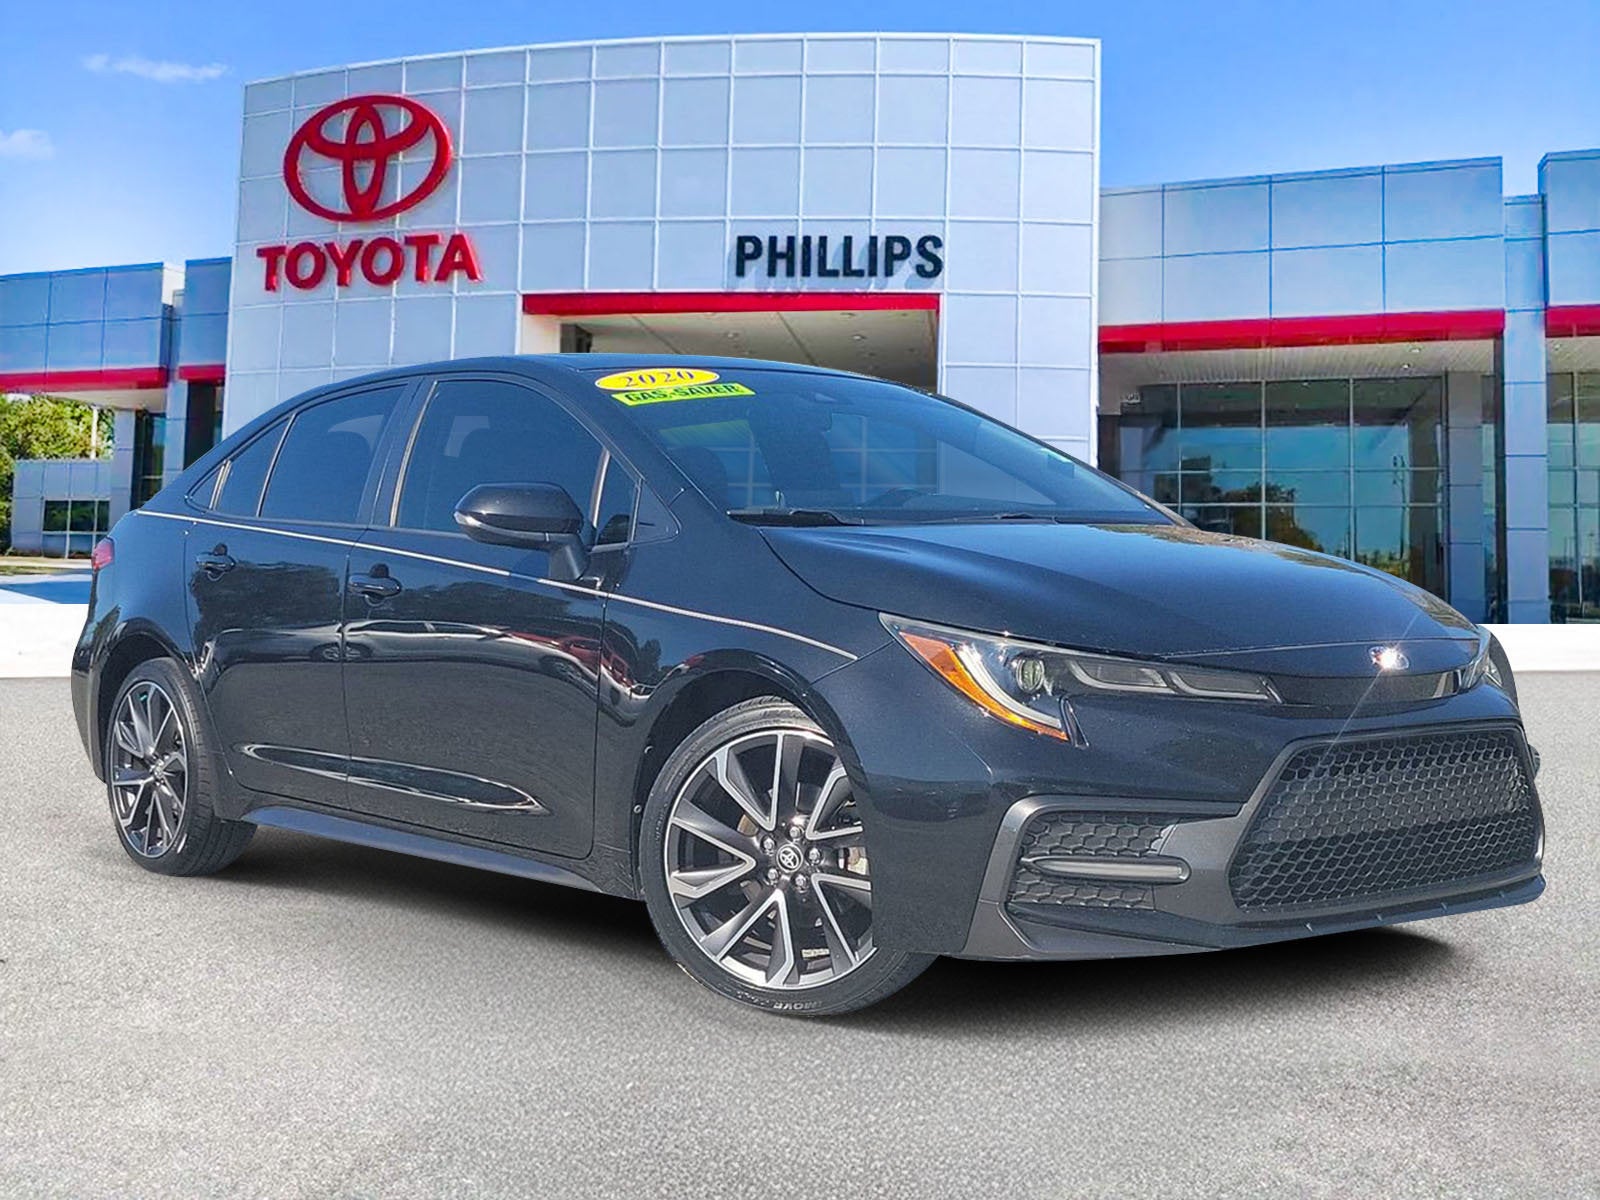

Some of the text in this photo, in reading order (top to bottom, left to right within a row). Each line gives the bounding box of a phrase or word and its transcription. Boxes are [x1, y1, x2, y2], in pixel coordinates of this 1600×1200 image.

[257, 233, 482, 291] TOYOTA
[736, 235, 943, 277] PHILLIPS
[624, 371, 695, 388] 2020
